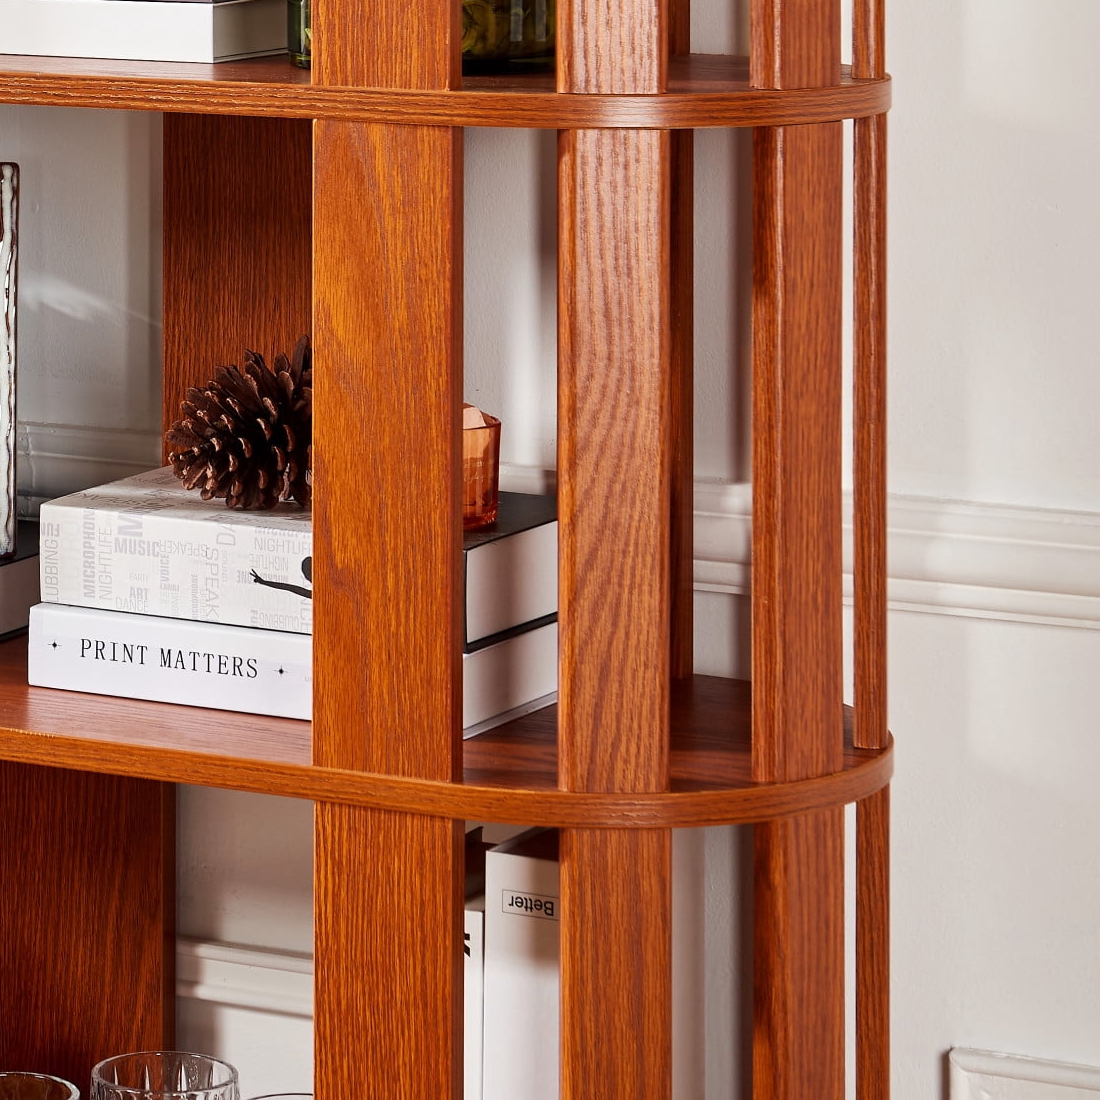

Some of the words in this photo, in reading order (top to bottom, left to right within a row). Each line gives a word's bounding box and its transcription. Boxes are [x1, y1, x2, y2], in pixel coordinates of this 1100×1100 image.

[114, 537, 160, 557] MUSIC
[99, 527, 113, 599] NIGHTLIFE
[129, 587, 149, 600] ART
[115, 597, 148, 612] DANCE
[80, 638, 148, 665] PRINT
[160, 650, 259, 679] MATTERS
[508, 894, 554, 916] Better
